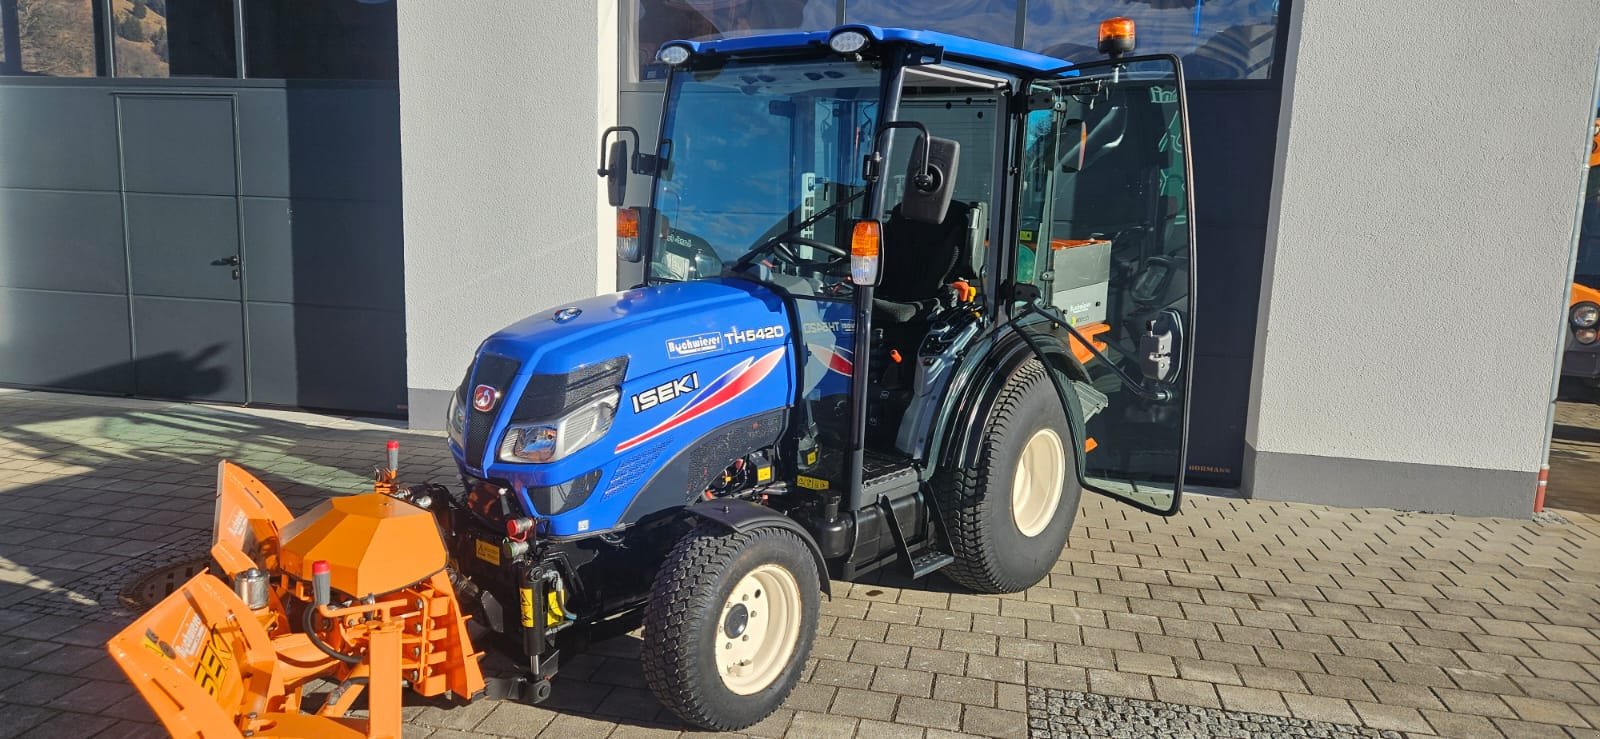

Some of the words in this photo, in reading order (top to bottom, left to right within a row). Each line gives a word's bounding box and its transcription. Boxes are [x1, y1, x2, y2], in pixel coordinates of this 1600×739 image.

[668, 336, 720, 353] Buchwieser
[724, 326, 784, 345] TH5420
[631, 370, 699, 414] ISEKI
